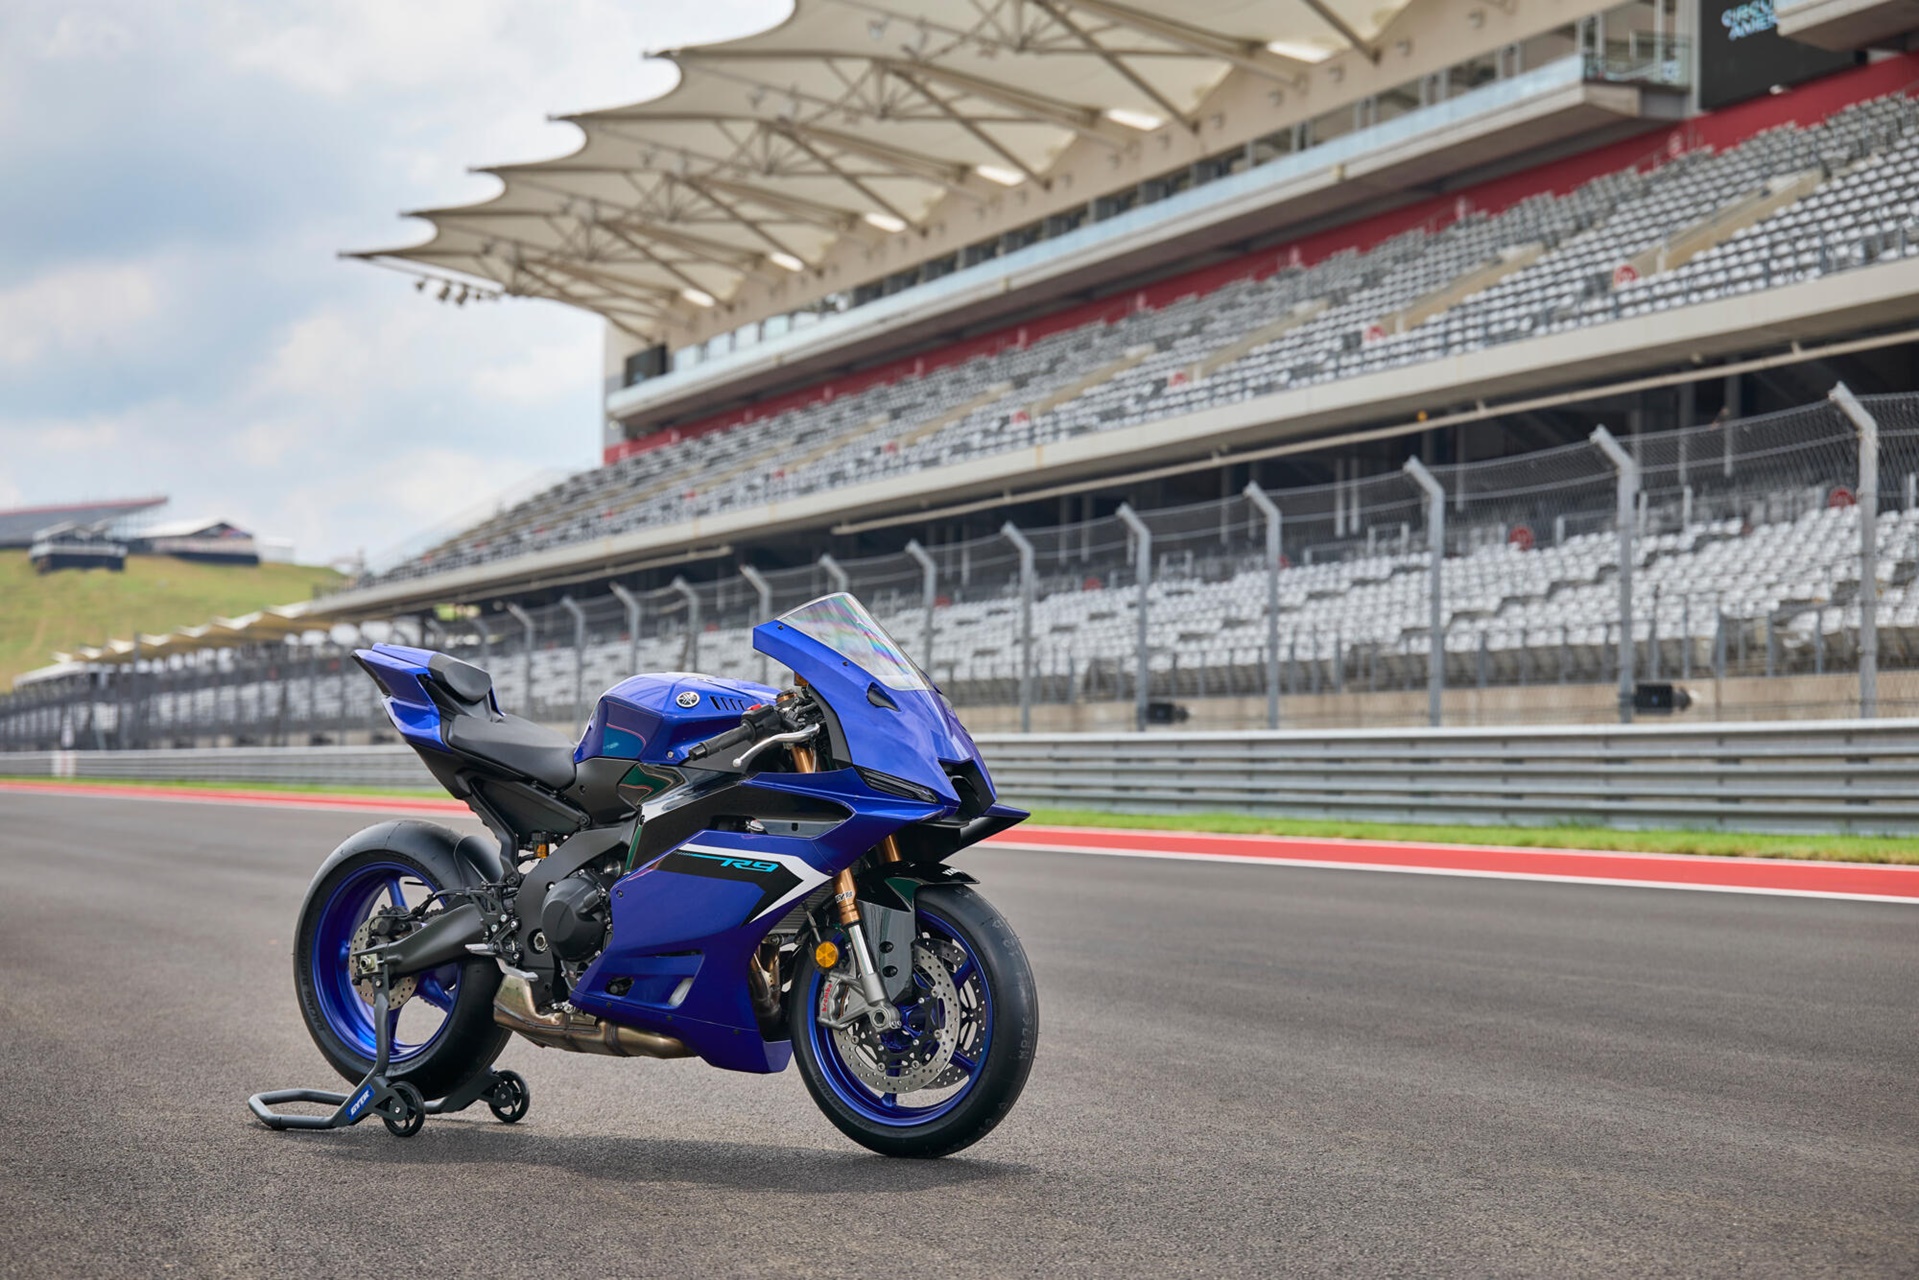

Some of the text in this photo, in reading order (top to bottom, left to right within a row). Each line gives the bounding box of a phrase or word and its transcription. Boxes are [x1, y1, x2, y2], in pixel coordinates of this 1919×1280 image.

[720, 857, 779, 873] R9
[821, 983, 832, 1013] brembo
[350, 1089, 370, 1116] GYTR
